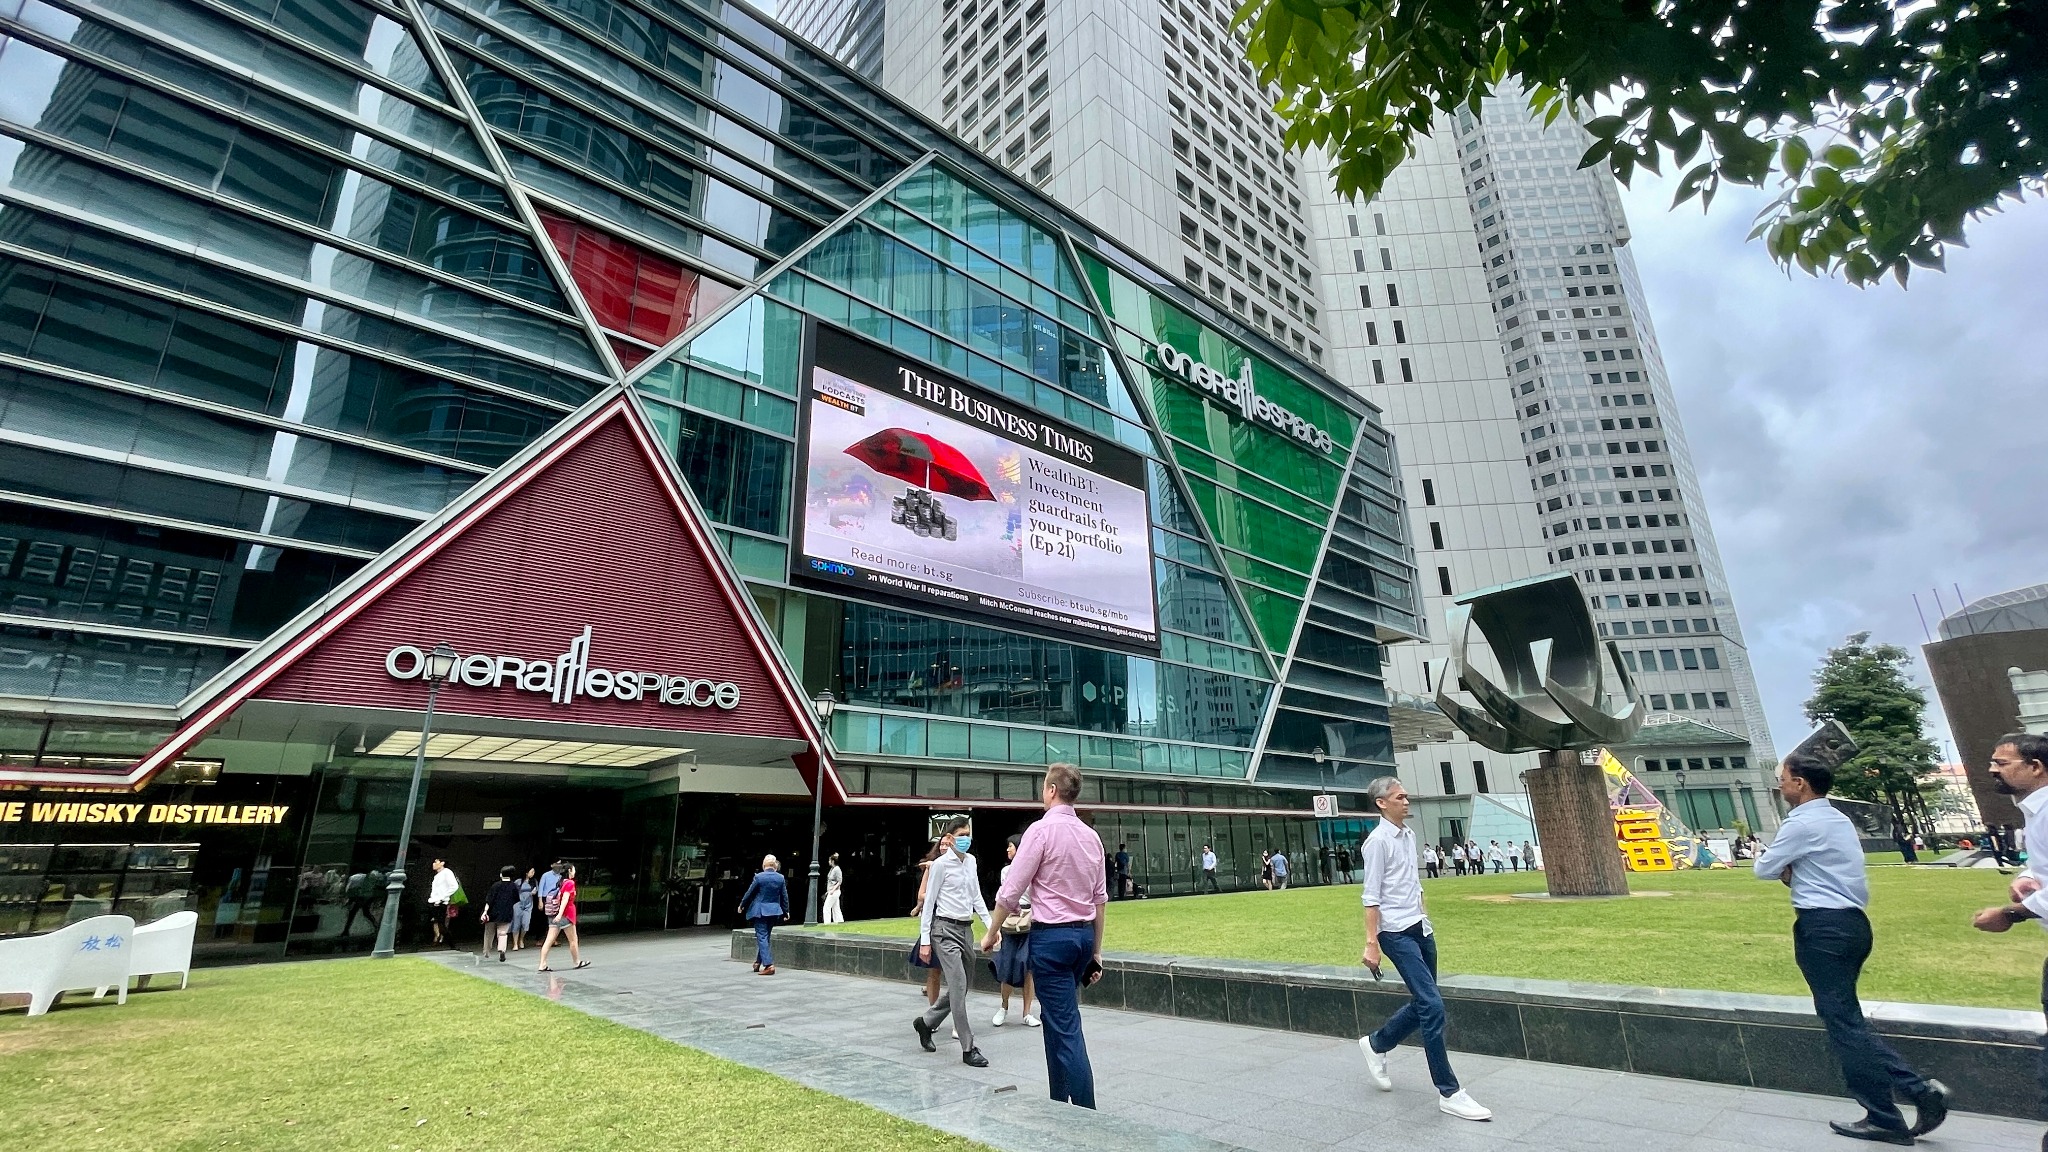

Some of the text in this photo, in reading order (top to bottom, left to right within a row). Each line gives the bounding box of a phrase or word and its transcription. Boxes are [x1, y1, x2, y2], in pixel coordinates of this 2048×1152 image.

[821, 394, 849, 409] WEALTH
[822, 384, 865, 405] PODCASTS
[898, 366, 946, 406] THE
[949, 387, 1038, 442] BUSINESS
[1040, 424, 1094, 464] TIMES
[1028, 457, 1099, 495] WealthBT:
[1028, 475, 1104, 514] Investment
[1028, 499, 1119, 536] guardrails for
[1029, 517, 1123, 555] your portfolio
[1030, 533, 1075, 562] (Ep 21)
[851, 547, 953, 582] Read more: bt.sg
[879, 575, 903, 588] World
[904, 580, 921, 591] War
[927, 586, 969, 602] reparations
[979, 597, 999, 609] Mitch
[999, 602, 1034, 616] McConnell
[1034, 608, 1059, 621] reaches
[1059, 616, 1072, 624] new
[1072, 618, 1100, 630] milestone
[1018, 587, 1130, 621] Subscribe: btsub.sg/mbo
[31, 802, 145, 823] WHISKY
[147, 804, 290, 824] DISTILLERY
